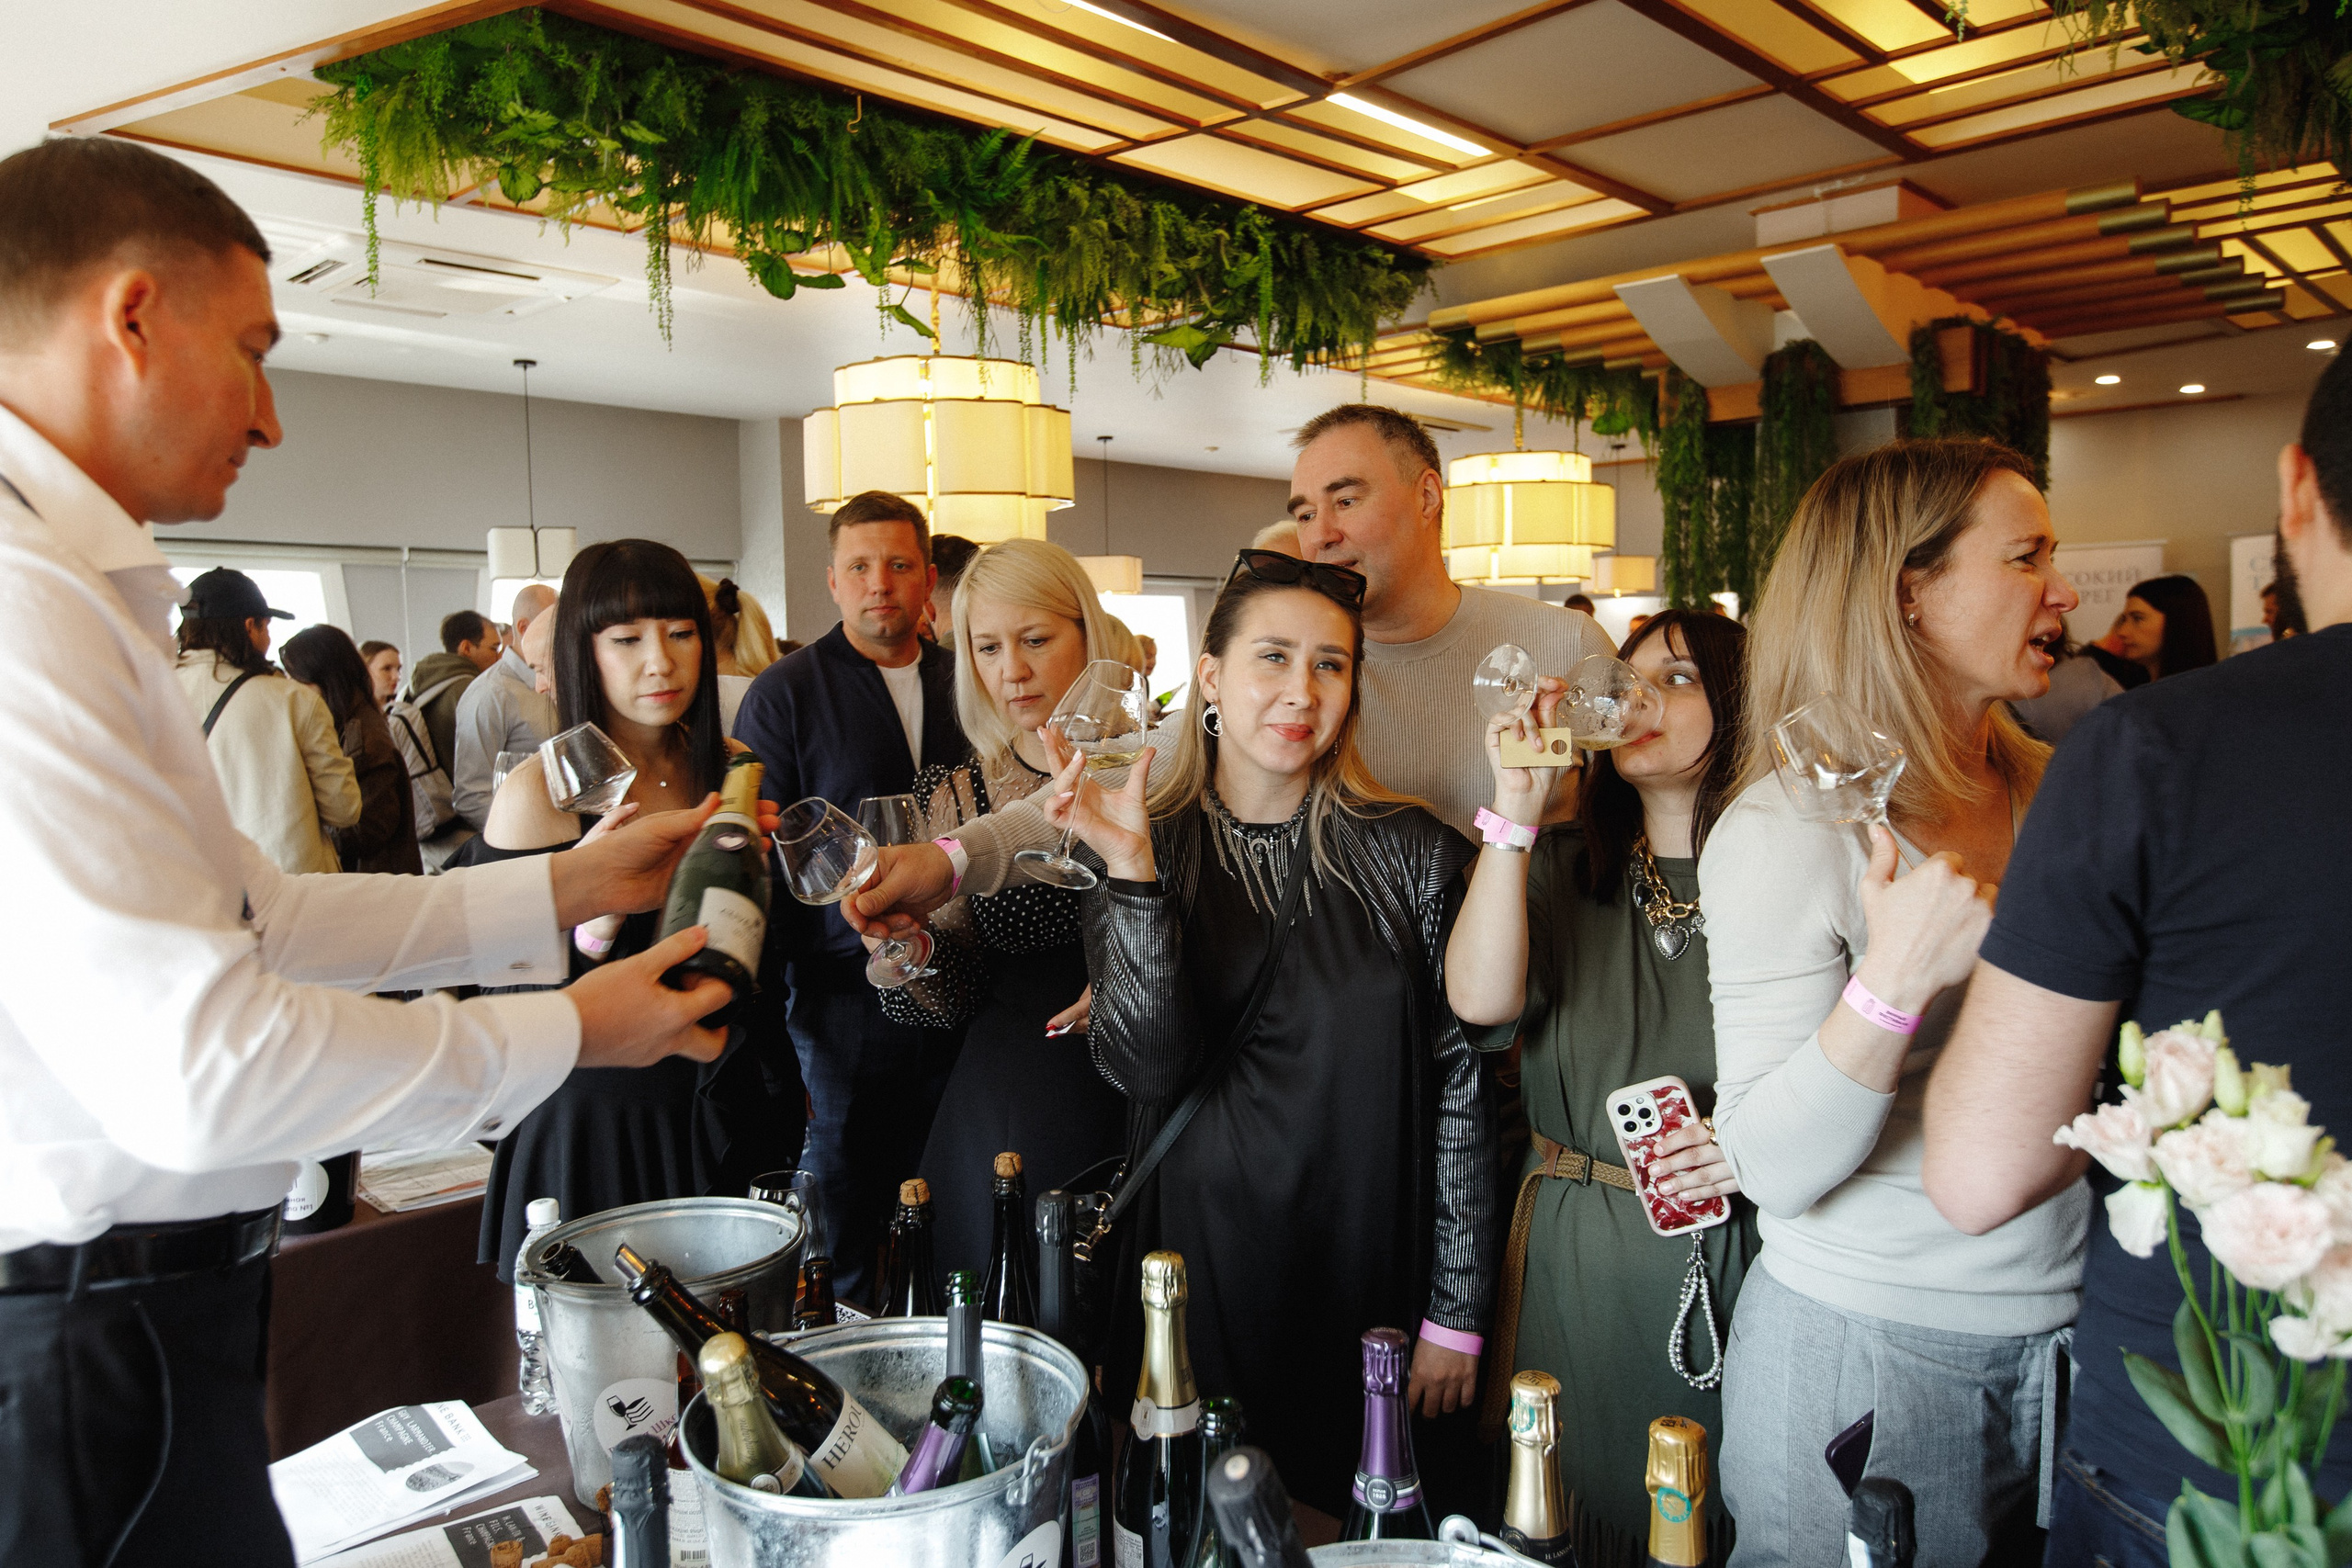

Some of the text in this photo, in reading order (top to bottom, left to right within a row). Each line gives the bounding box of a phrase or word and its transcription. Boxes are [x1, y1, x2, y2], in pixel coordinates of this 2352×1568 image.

[2064, 566, 2140, 585] СОКИЙ
[2080, 590, 2114, 604] РЕГ
[398, 1409, 412, 1420] GUY
[650, 1414, 676, 1434] Шко
[375, 1420, 393, 1442] France
[387, 1415, 413, 1446] CHAMPAGNE
[445, 1413, 464, 1436] BANK
[462, 1526, 478, 1545] France
